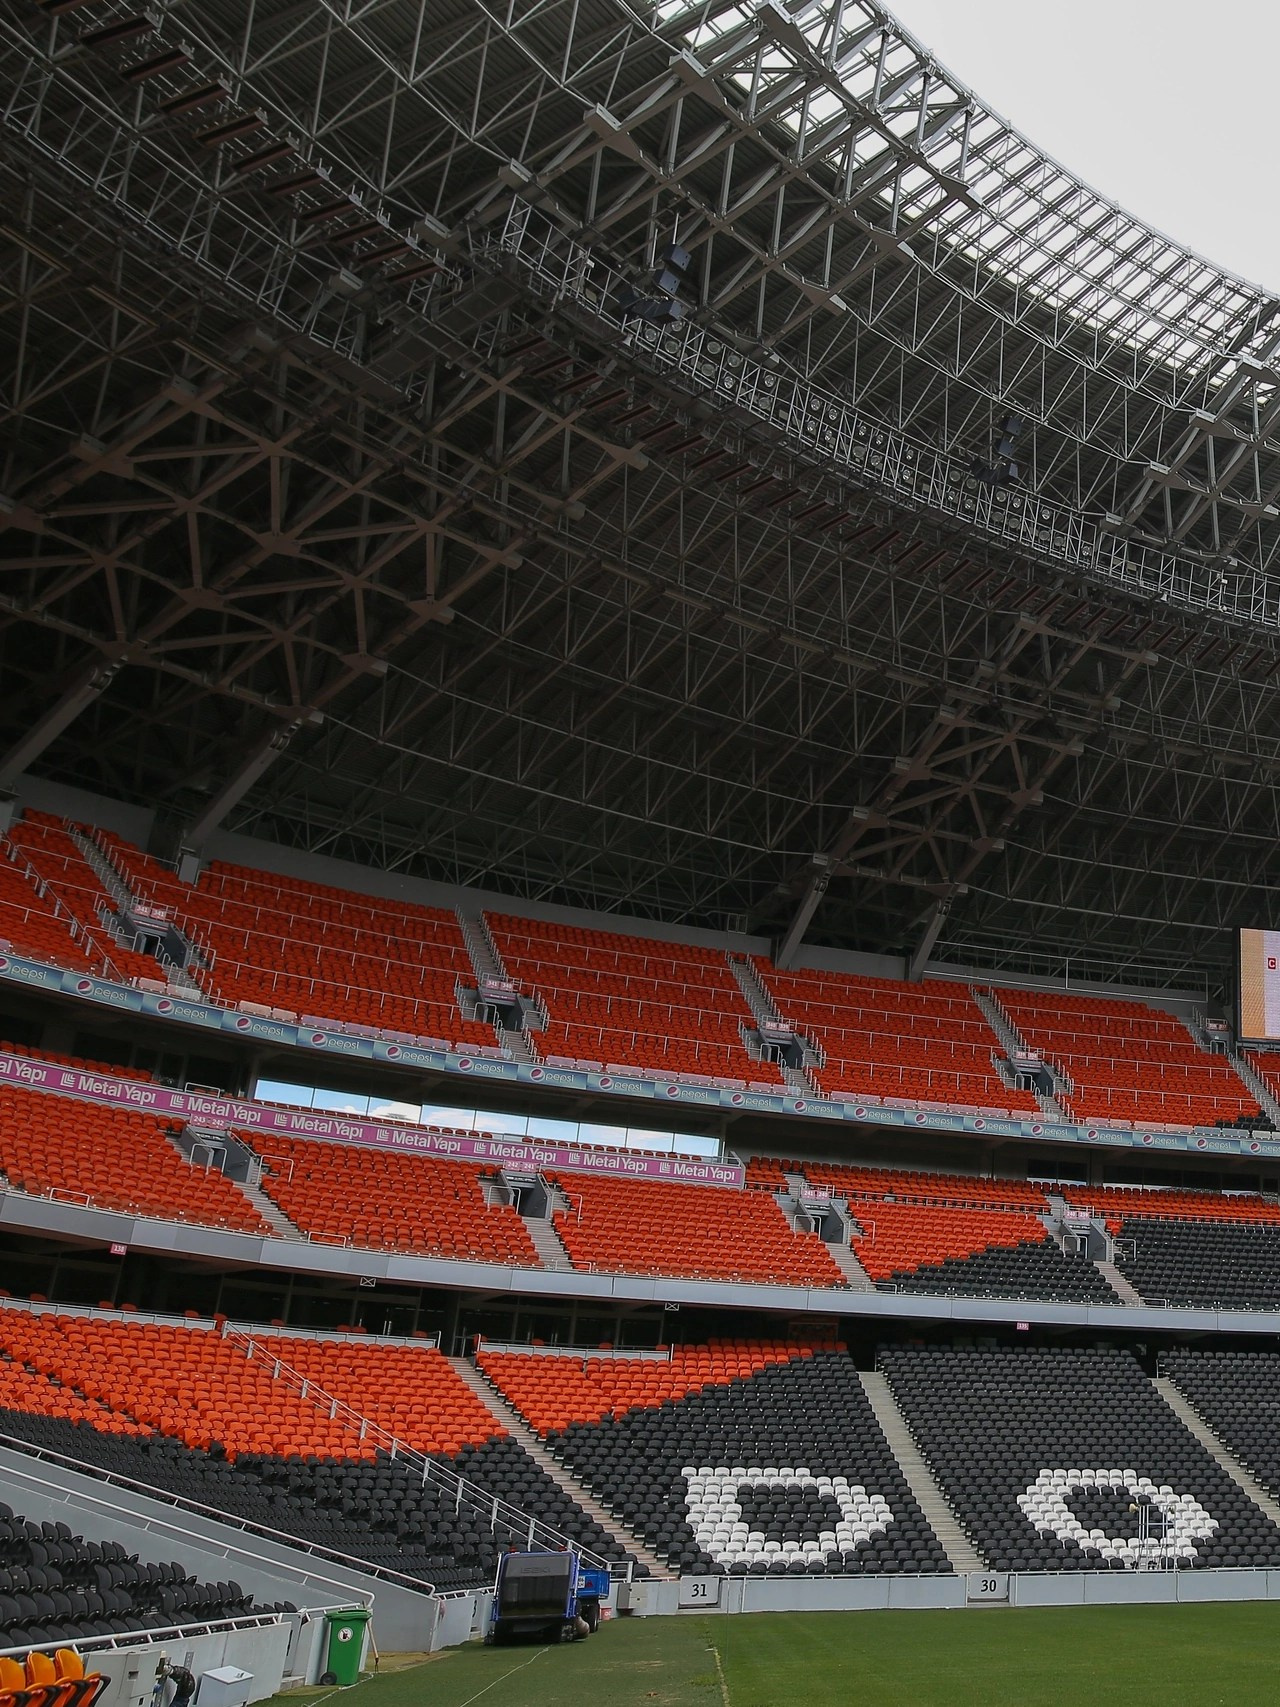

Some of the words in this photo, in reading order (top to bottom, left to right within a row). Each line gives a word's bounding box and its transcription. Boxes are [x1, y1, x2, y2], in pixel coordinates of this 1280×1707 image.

[1268, 958, 1276, 969] С
[11, 965, 47, 981] pepsi
[94, 985, 128, 1001] pepsi
[174, 1004, 208, 1020] pepsi
[253, 1021, 284, 1037] pepsi
[327, 1037, 360, 1051] pepsi
[402, 1050, 432, 1064] pepsi
[474, 1062, 504, 1075] pepsi
[546, 1072, 574, 1085] pepsi
[78, 1076, 122, 1098] Metal
[614, 1081, 642, 1093] pepsi
[680, 1089, 708, 1101] pepsi
[187, 1097, 229, 1116] Metal
[745, 1097, 772, 1109] pepsi
[808, 1104, 833, 1115] pepsi
[868, 1110, 893, 1121] pepsi
[928, 1116, 953, 1127] pepsi
[291, 1116, 331, 1133] Metal
[987, 1122, 1011, 1133] pepsi
[1044, 1127, 1068, 1138] pepsi
[1099, 1132, 1122, 1143] pepsi
[392, 1131, 432, 1148] Metal
[489, 1143, 527, 1159] Metal
[583, 1153, 619, 1169] Metal
[674, 1163, 710, 1178] Metal
[691, 1584, 707, 1597] 31
[981, 1580, 997, 1592] 30
